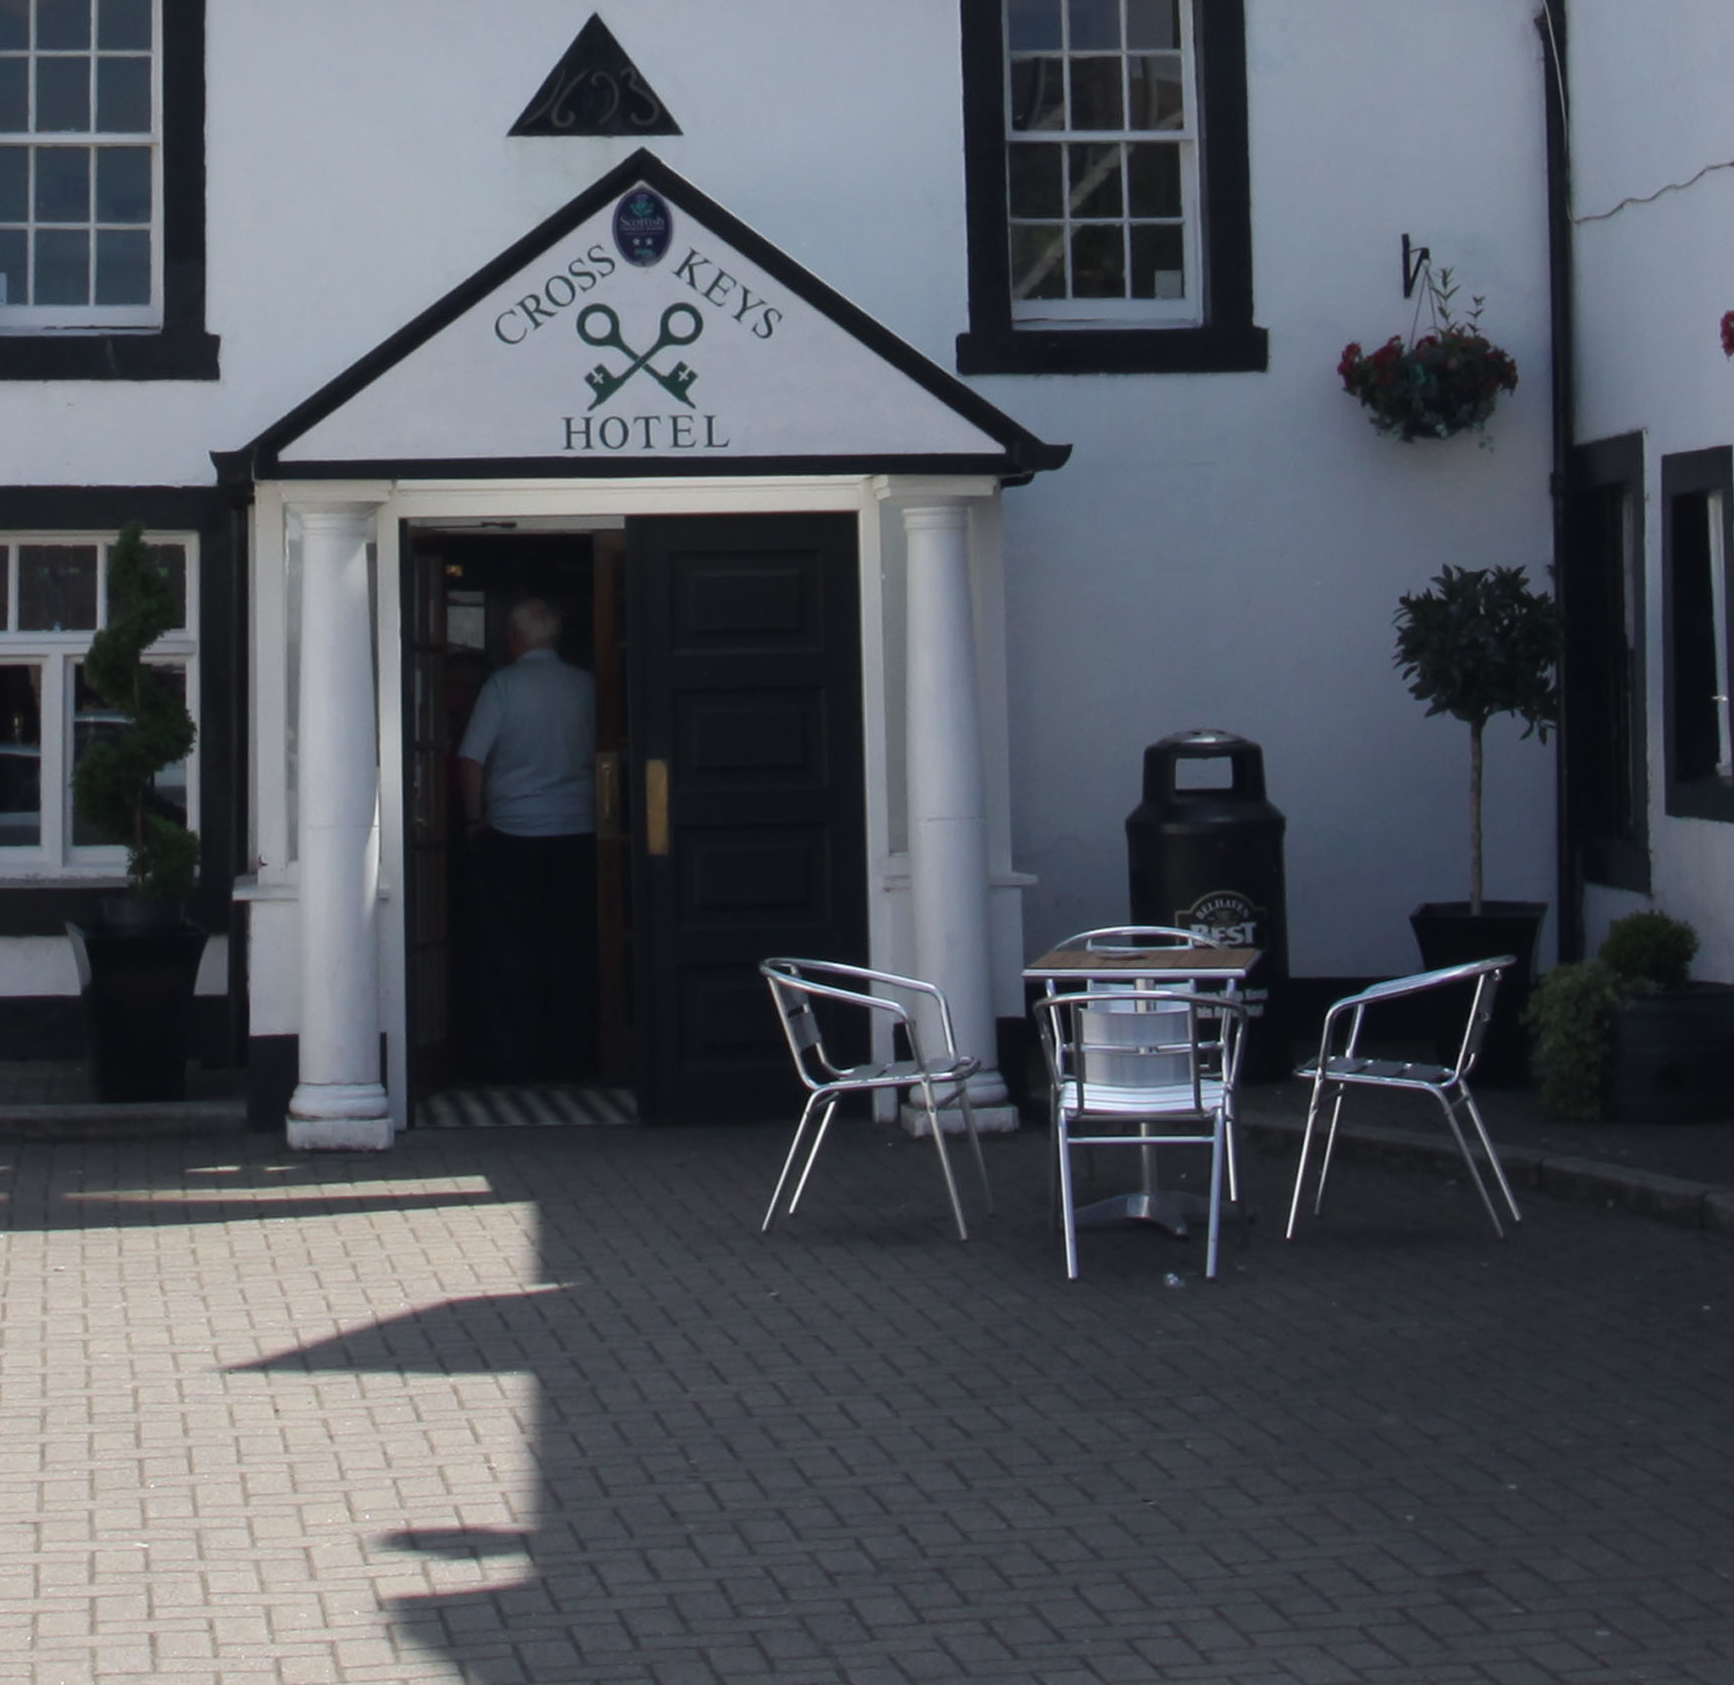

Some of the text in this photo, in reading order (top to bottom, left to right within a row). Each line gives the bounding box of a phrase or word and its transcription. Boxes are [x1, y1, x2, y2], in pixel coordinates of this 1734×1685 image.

[619, 216, 664, 228] Scottish
[494, 244, 783, 345] CROSS KEYS
[562, 415, 730, 450] HOTEL
[1195, 899, 1250, 920] BELHAVEN
